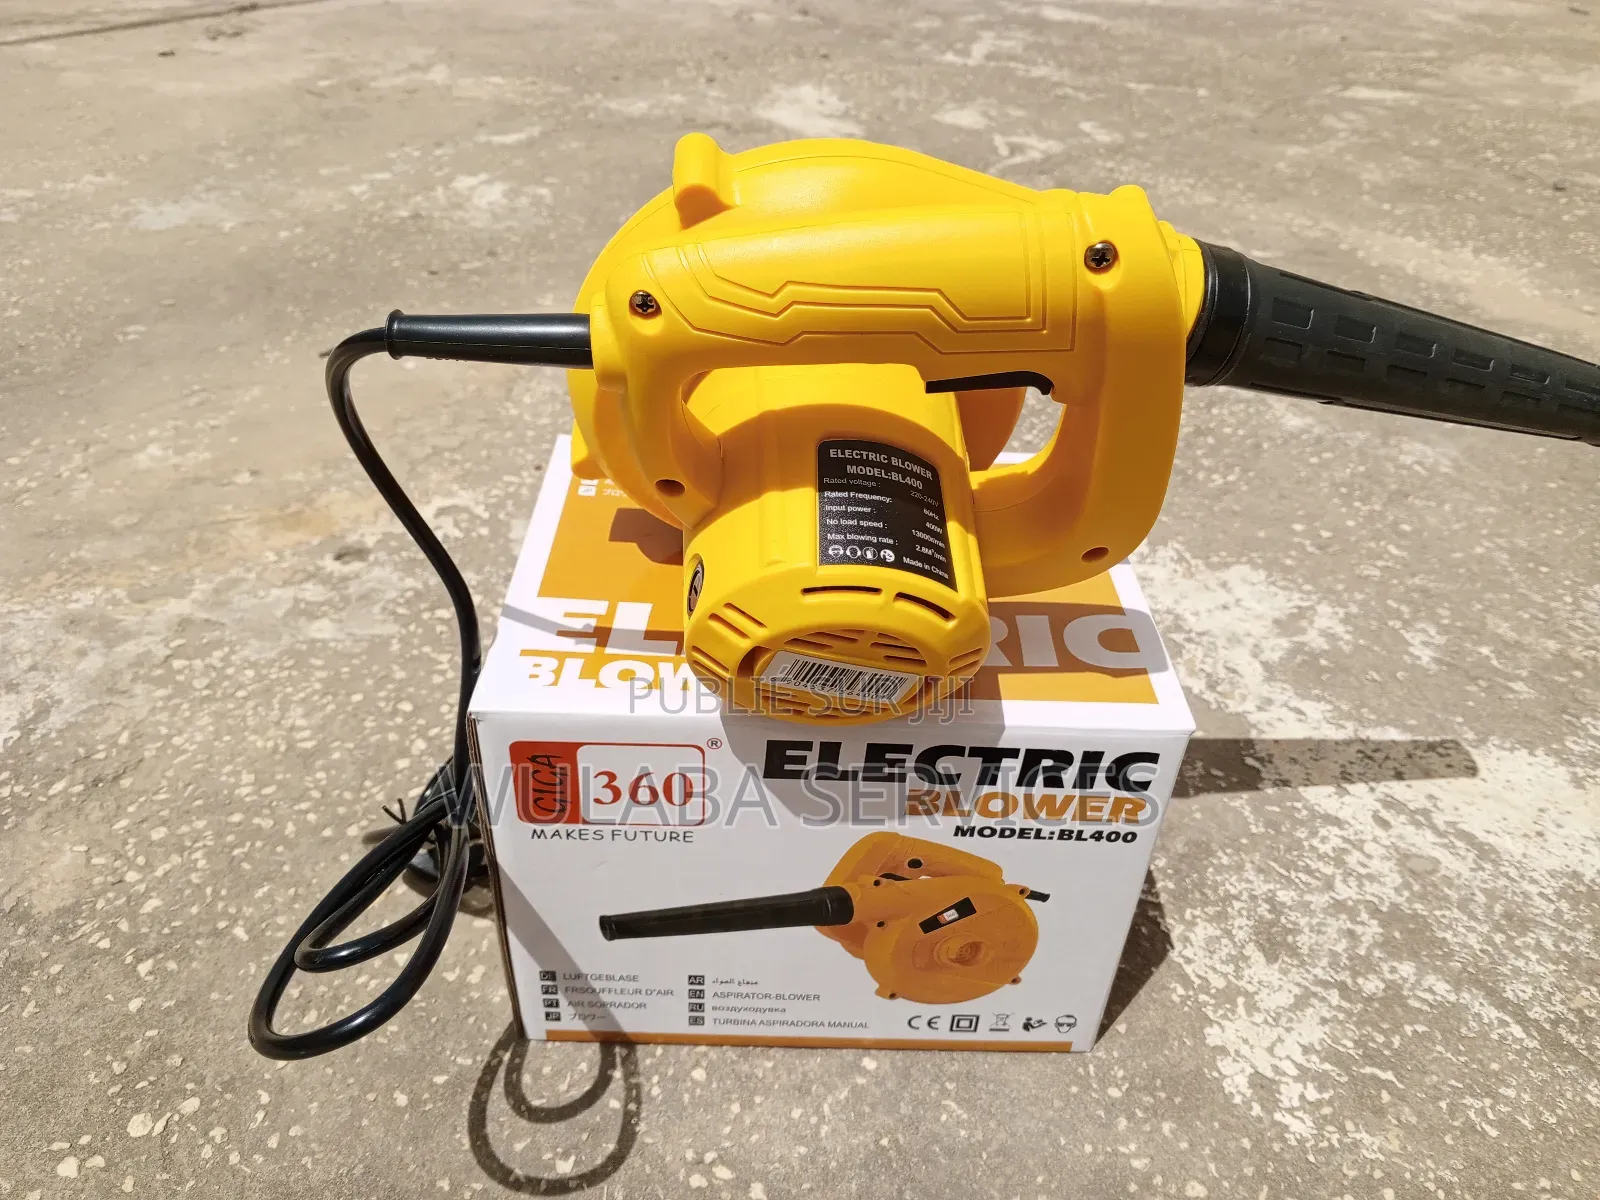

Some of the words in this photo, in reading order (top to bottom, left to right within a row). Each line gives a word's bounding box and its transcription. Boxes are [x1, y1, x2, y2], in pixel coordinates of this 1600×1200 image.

[829, 449, 888, 464] ELECTRIC
[891, 456, 933, 480] BLOWER
[846, 465, 923, 490] MODEL:BL400
[850, 478, 877, 487] voltage
[824, 490, 849, 498] Rated
[850, 491, 893, 503] Frequency:
[847, 506, 871, 514] power
[859, 520, 883, 528] speed
[846, 534, 877, 543] blowing
[878, 537, 894, 545] rate
[902, 556, 923, 568] Made
[924, 563, 931, 571] in
[931, 566, 949, 579] China
[518, 655, 704, 690] BLOW
[763, 740, 1160, 793] ELECTRIC
[592, 770, 695, 807] 360
[904, 788, 1147, 824] BLOWER
[531, 828, 604, 842] MAKES
[611, 829, 694, 844] FUTURE
[953, 825, 1138, 844] MODEL:BL400
[562, 973, 640, 982] LUFTGEBLASE
[689, 976, 704, 984] AR
[542, 985, 557, 994] FR
[689, 990, 704, 998] EN
[712, 991, 820, 1001] ASPIRATOR-BLOWER
[689, 1003, 704, 1012] RU
[712, 1018, 757, 1026] TURBINA
[758, 1019, 827, 1028] ASPIRADORA
[827, 1020, 870, 1029] MANUAL
